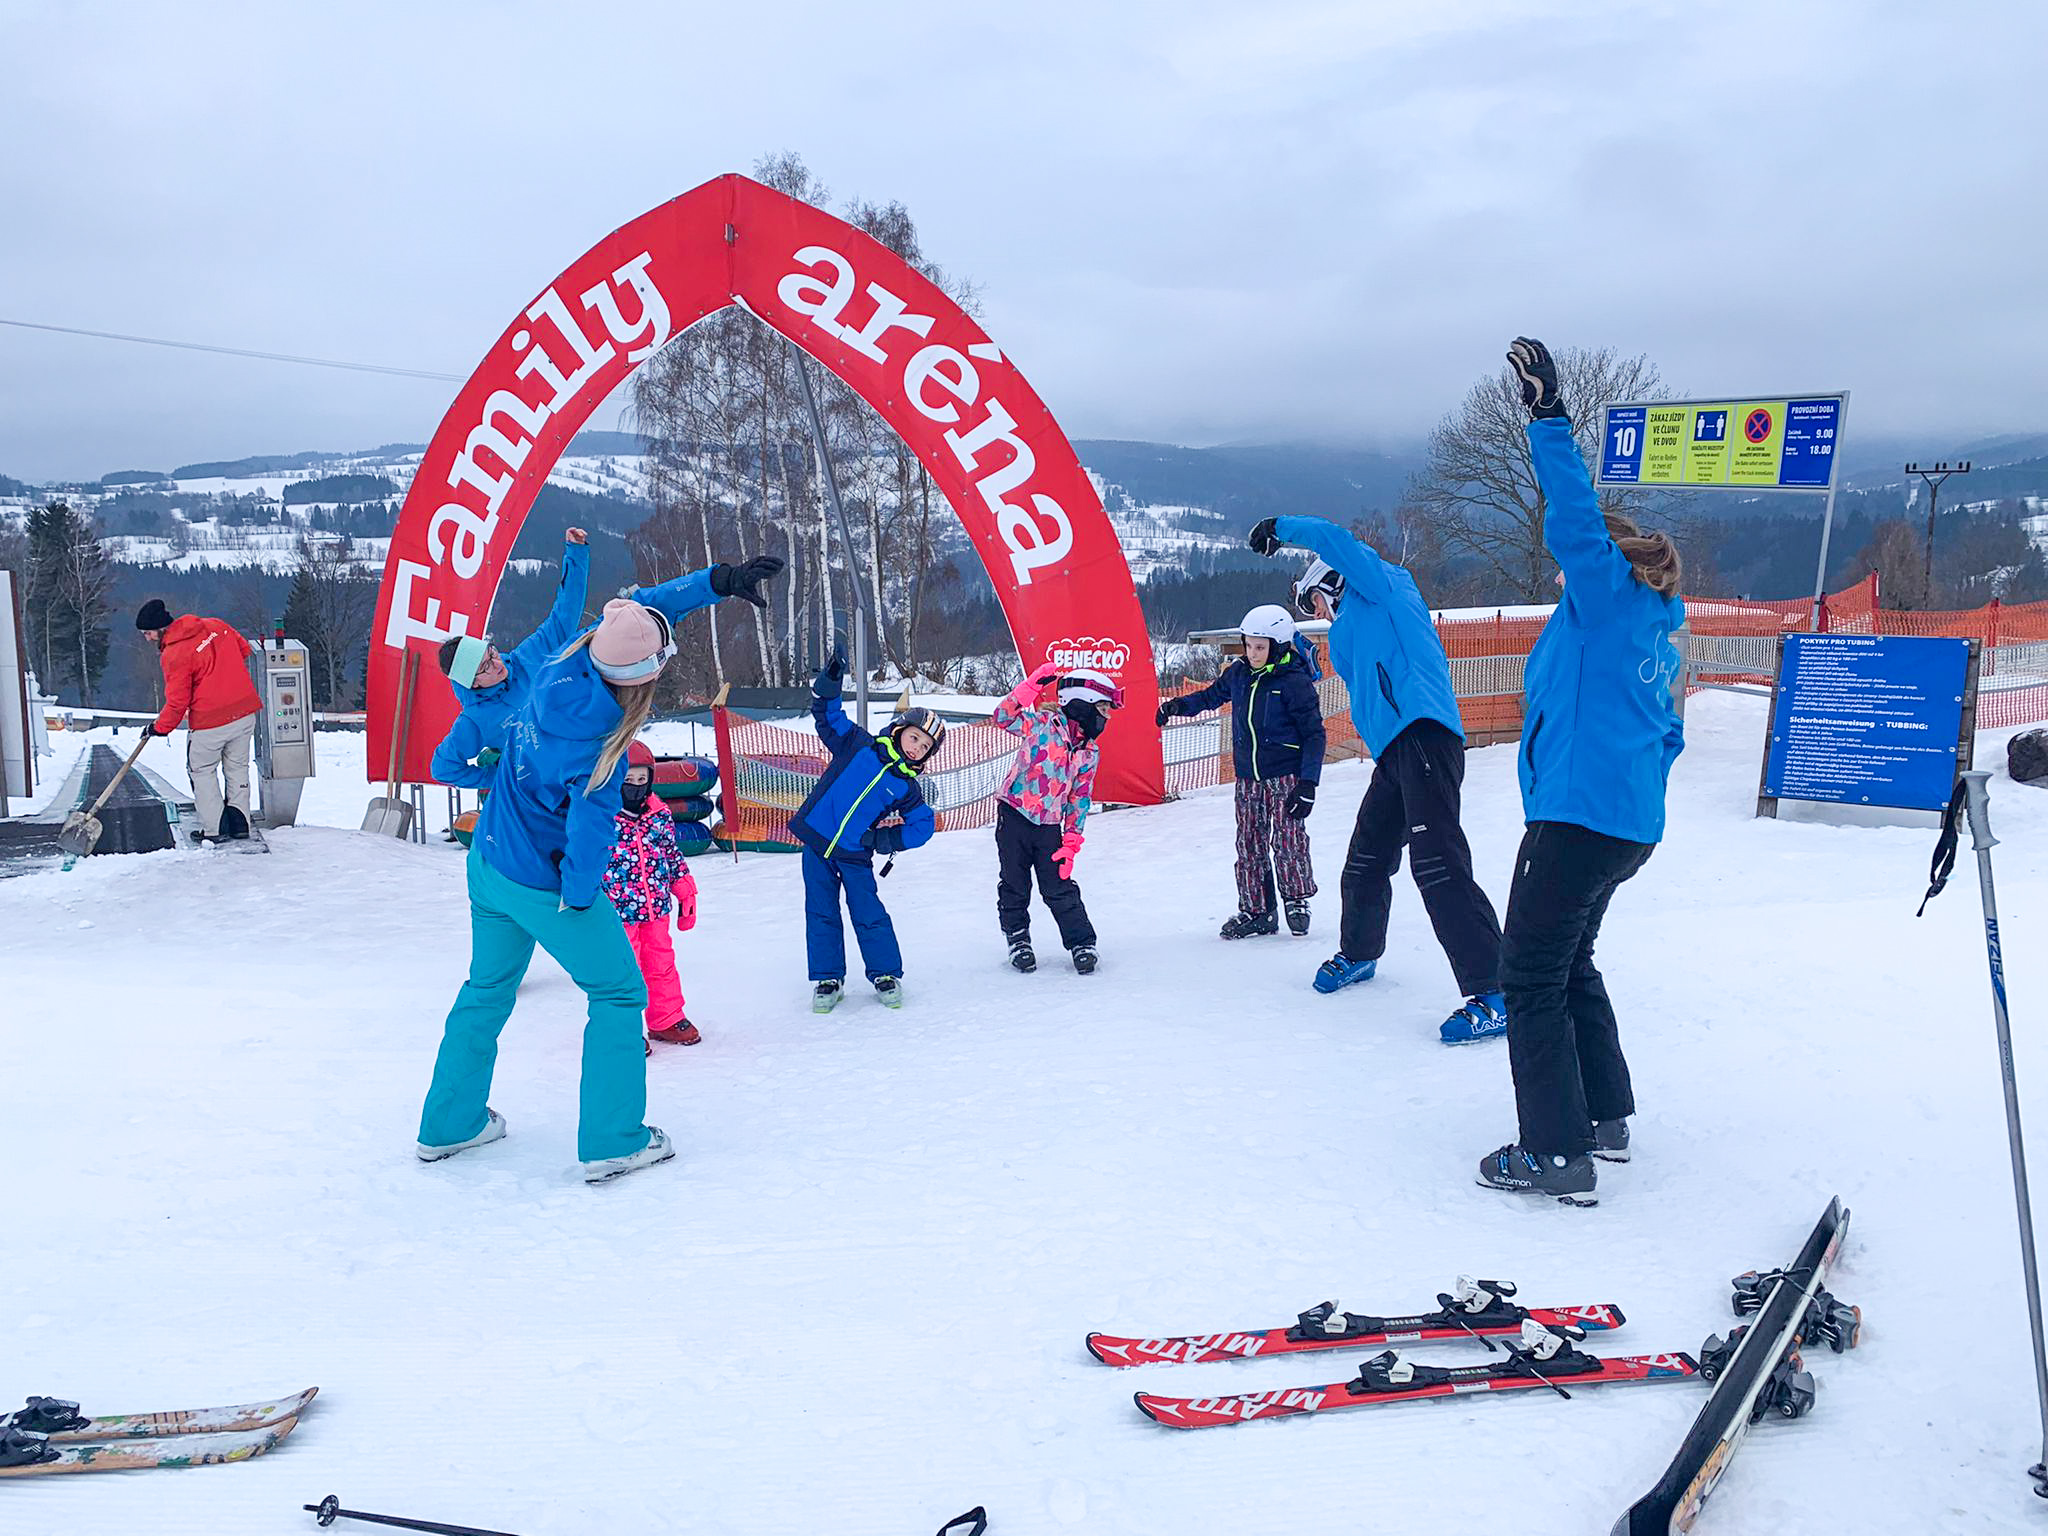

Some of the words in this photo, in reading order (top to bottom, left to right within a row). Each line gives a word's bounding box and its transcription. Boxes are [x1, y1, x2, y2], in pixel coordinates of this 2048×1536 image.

[1791, 405, 1818, 414] PROVOZNÍ
[1819, 405, 1834, 414] DOBA
[1650, 412, 1669, 423] ZÁKAZ
[1669, 411, 1686, 422] JÍZDY
[1653, 425, 1660, 434] VE
[1660, 424, 1680, 434] ČLUNU
[1816, 429, 1834, 439] 9.00
[1614, 427, 1636, 457] 10
[1653, 437, 1660, 446] VE
[1661, 437, 1677, 446] DVOU
[385, 250, 672, 651] Family
[777, 245, 1074, 586] aréna
[1810, 445, 1832, 455] 18.00
[1053, 649, 1125, 670] BENECKO
[1789, 716, 1875, 729] Sicherheitsanweisung
[1986, 917, 2003, 976] FIZAN
[1470, 1013, 1508, 1035] LAN
[1493, 1176, 1532, 1188] salomon
